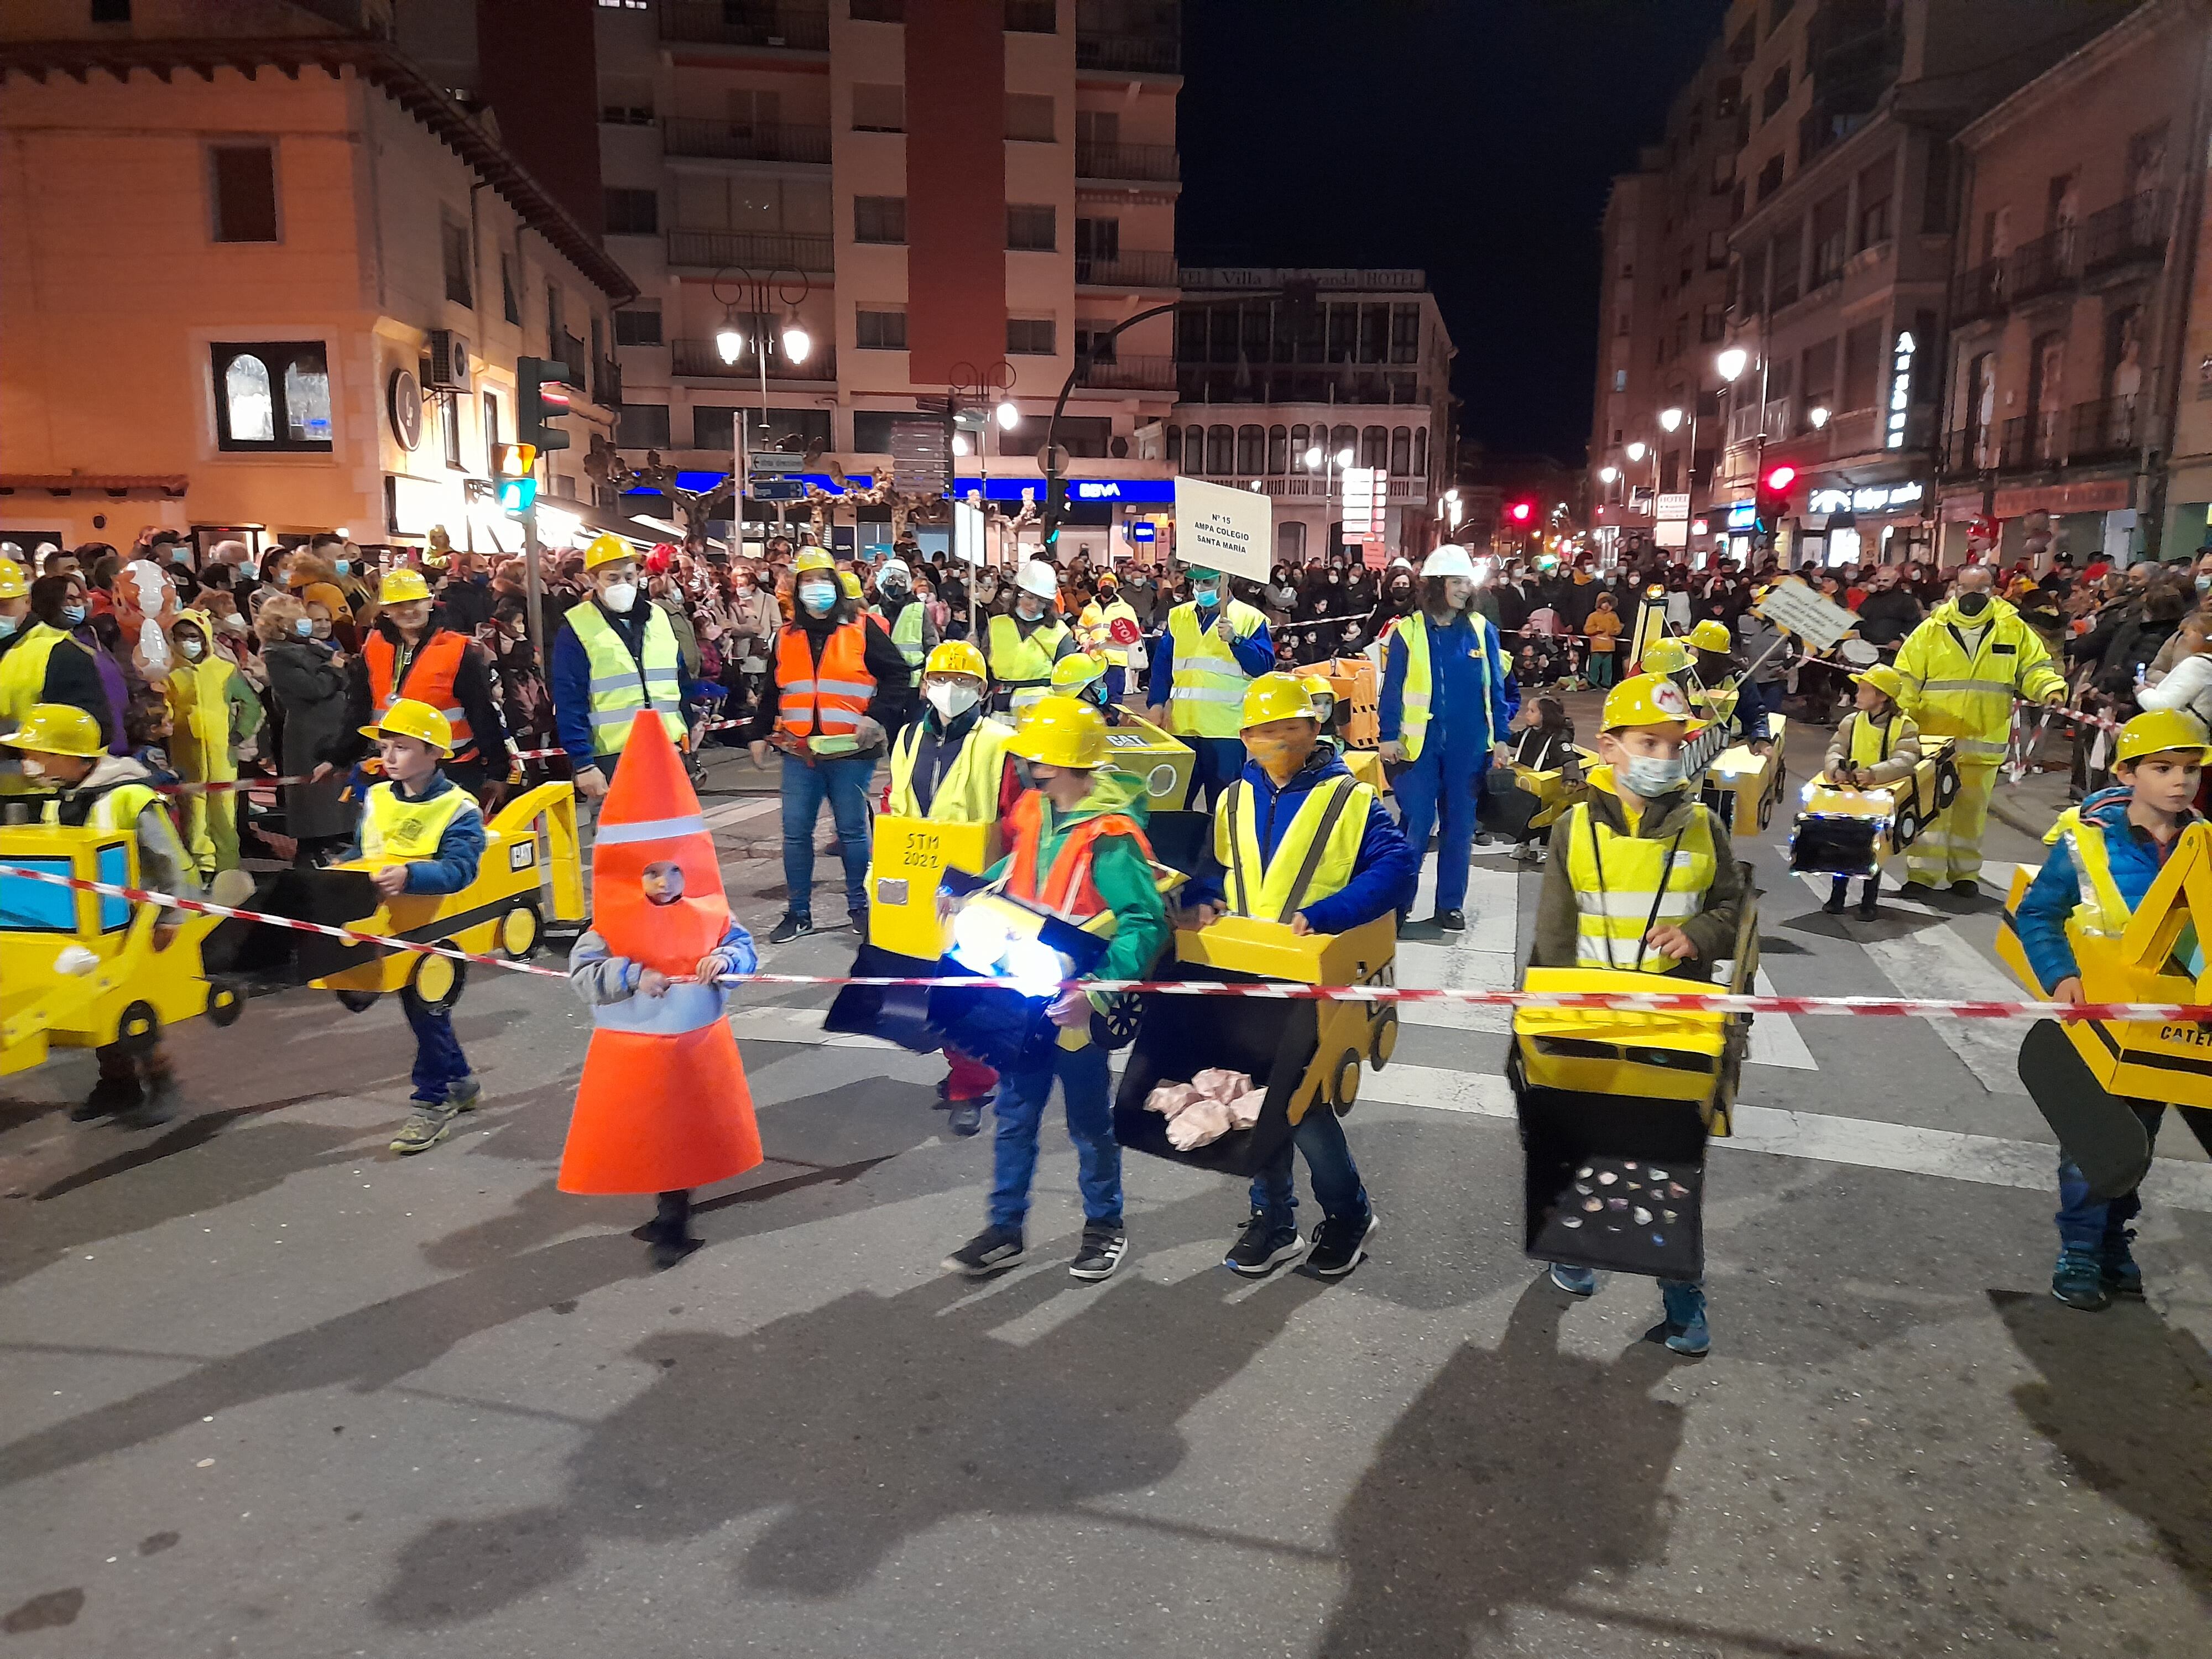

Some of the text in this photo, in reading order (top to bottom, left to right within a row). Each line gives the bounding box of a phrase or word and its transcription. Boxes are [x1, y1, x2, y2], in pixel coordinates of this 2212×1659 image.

[1221, 271, 1261, 285] Villa
[1079, 483, 1120, 498] BBVA
[1222, 516, 1231, 524] 15
[1194, 521, 1250, 541] AMPA COLEGIO
[1197, 534, 1221, 547] SANTA
[1114, 619, 1135, 643] STOP
[1657, 690, 1683, 705] M
[1106, 734, 1152, 747] CAT
[906, 833, 939, 850] STM
